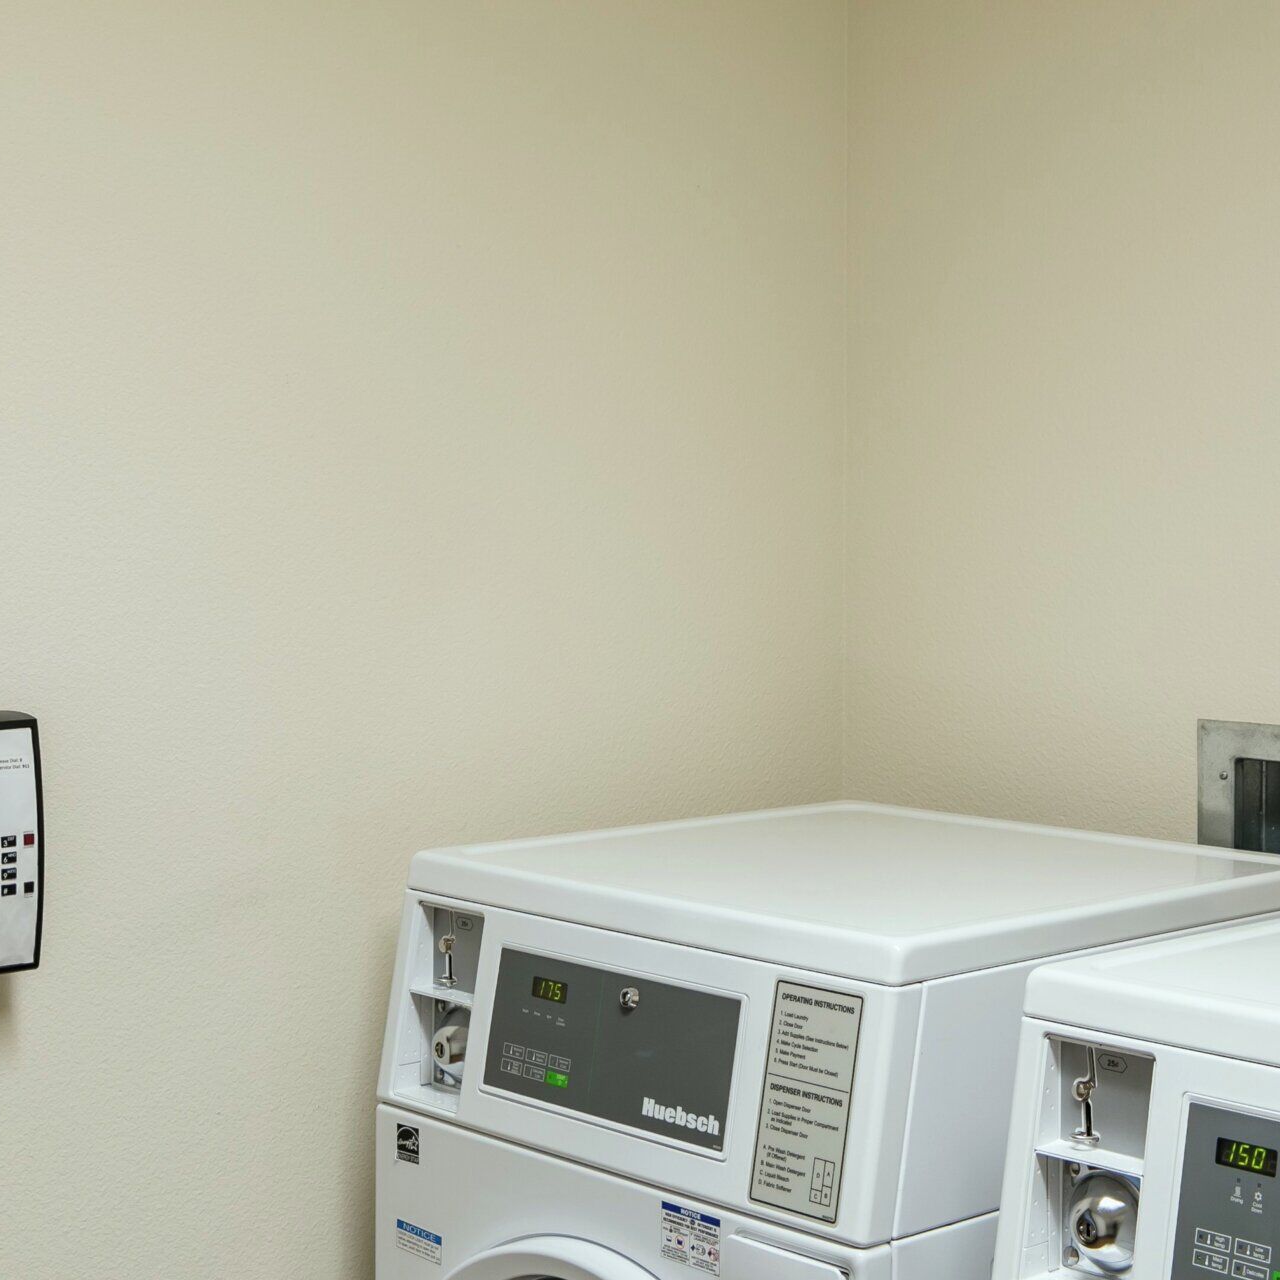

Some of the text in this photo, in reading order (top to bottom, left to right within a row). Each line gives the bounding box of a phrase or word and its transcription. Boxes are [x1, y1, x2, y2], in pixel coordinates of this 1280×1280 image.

[541, 980, 562, 1000] 175
[782, 992, 855, 1014] OPERATING INSTRUCTIONS
[770, 1082, 843, 1107] DISPENSER INSTRUCTIONS
[642, 1097, 719, 1136] Huebsch
[1229, 1142, 1266, 1170] 150
[680, 1208, 700, 1219] NOTICE
[403, 1223, 436, 1242] NOTICE
